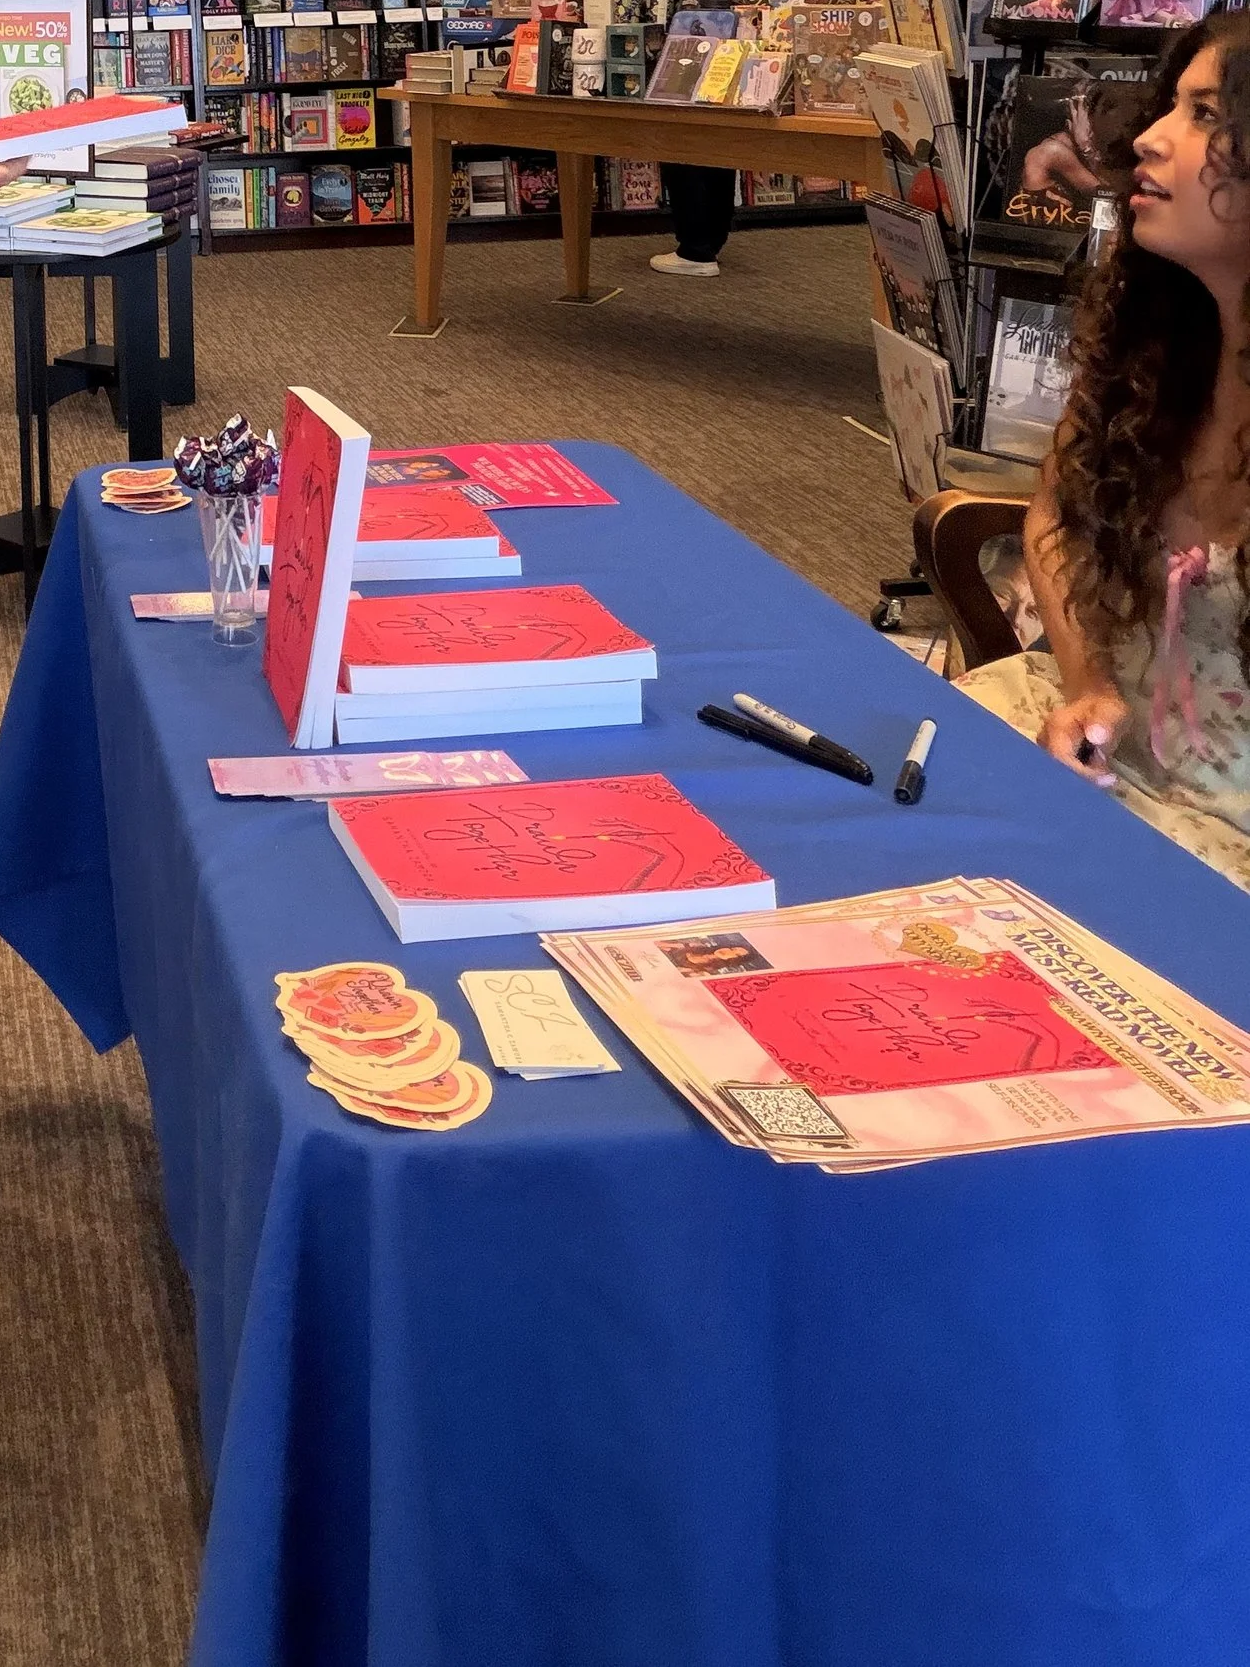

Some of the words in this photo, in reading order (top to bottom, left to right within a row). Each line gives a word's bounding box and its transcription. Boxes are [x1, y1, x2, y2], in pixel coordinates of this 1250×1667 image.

[821, 10, 855, 23] SHIP
[1002, 4, 1075, 20] MADONNA
[35, 21, 68, 38] 50%
[1, 43, 62, 65] VEG
[215, 44, 236, 56] DICE
[336, 91, 350, 100] LAST
[340, 100, 370, 109] BROOKLYN
[1006, 193, 1092, 225] Eryka
[423, 802, 521, 883] Together
[498, 801, 598, 875] Drawn
[1008, 932, 1129, 1028] MUST-READ
[1123, 1023, 1200, 1083] NOVEL
[1027, 926, 1136, 1007] DISCOVER
[1131, 1003, 1190, 1043] THE
[1187, 1040, 1244, 1082] NEW
[821, 981, 924, 1063] Together
[874, 981, 981, 1055] Drawn
